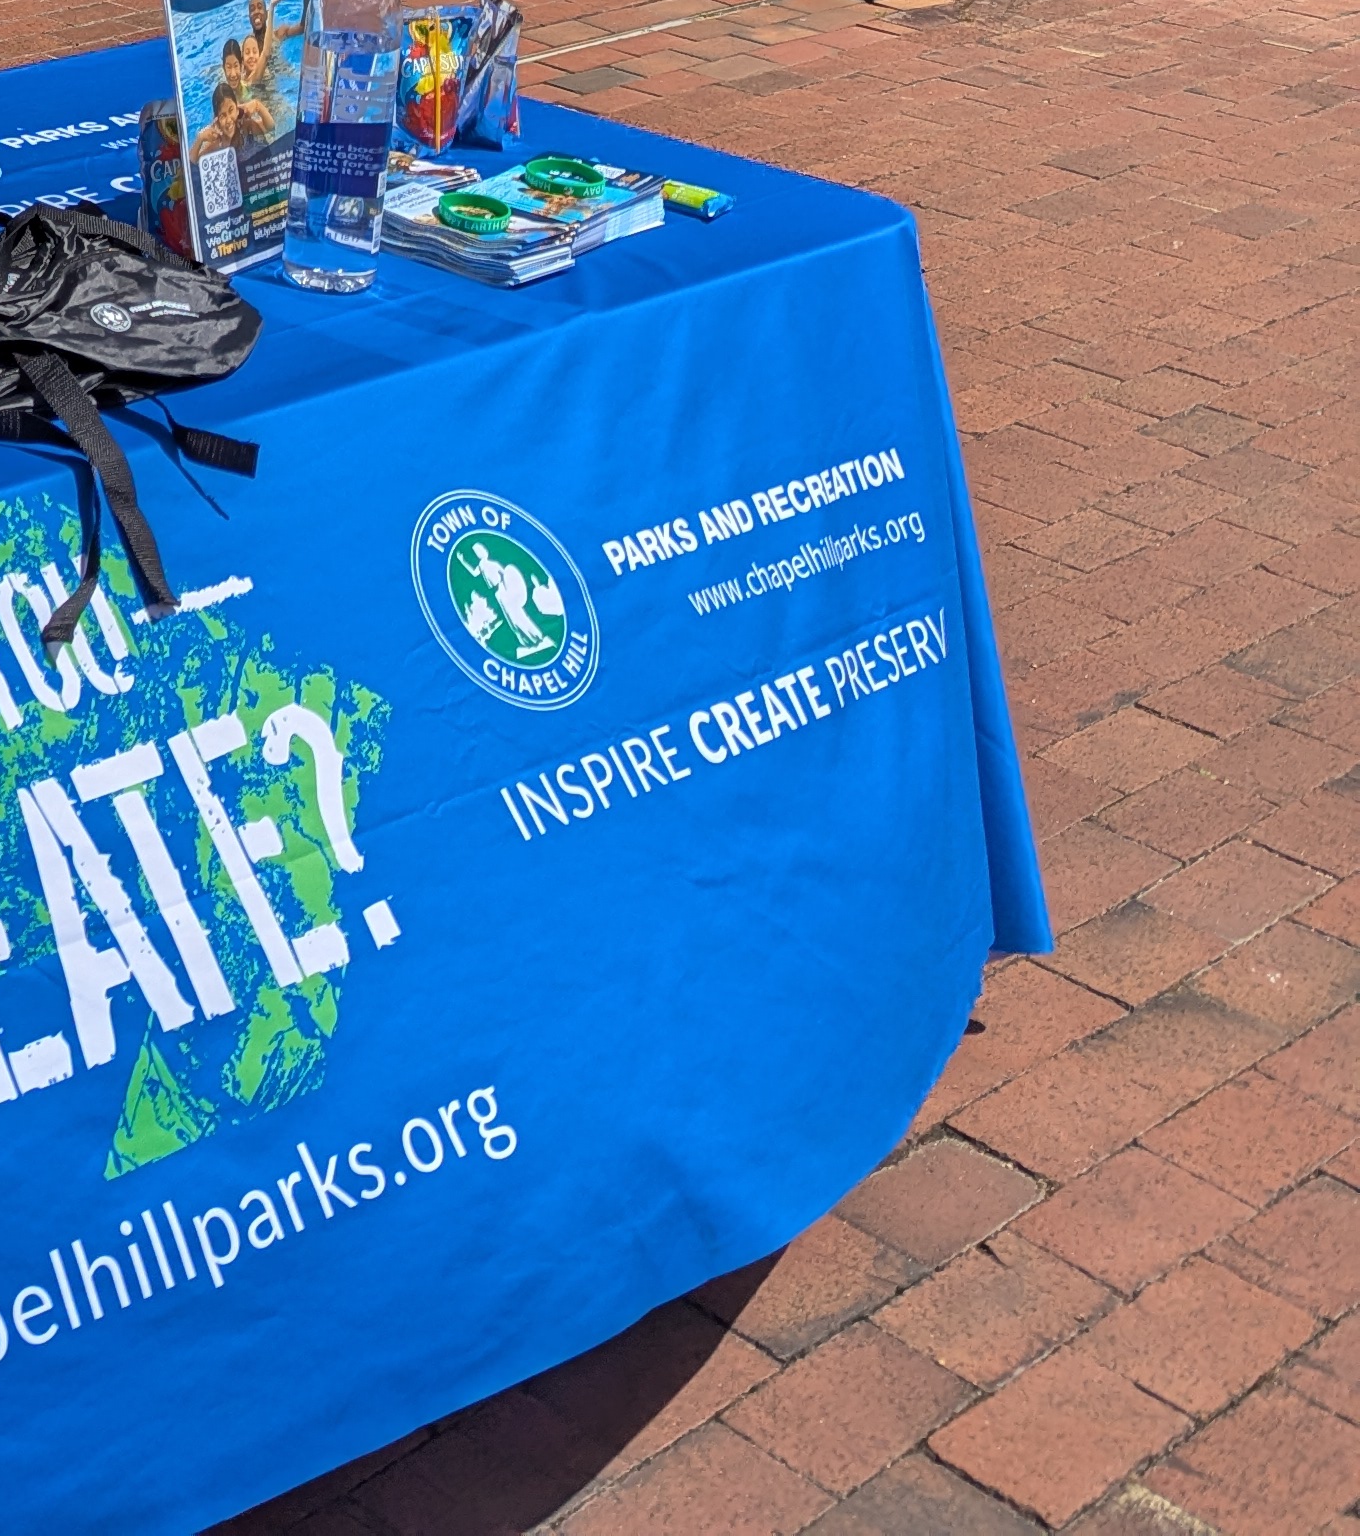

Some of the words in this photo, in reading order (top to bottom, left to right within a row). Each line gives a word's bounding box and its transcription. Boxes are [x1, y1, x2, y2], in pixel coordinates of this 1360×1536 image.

[427, 504, 476, 552] TOWN
[481, 506, 511, 530] OF
[602, 518, 698, 576] PARKS
[699, 500, 753, 546] AND
[751, 448, 905, 525] RECREATION
[688, 510, 926, 616] www.chapelhillparks.org
[483, 658, 568, 696] CHAPEL
[562, 631, 588, 677] HILL
[500, 725, 691, 841] INSPIRE
[688, 665, 831, 764] CREATE
[825, 608, 949, 709] PRESERV
